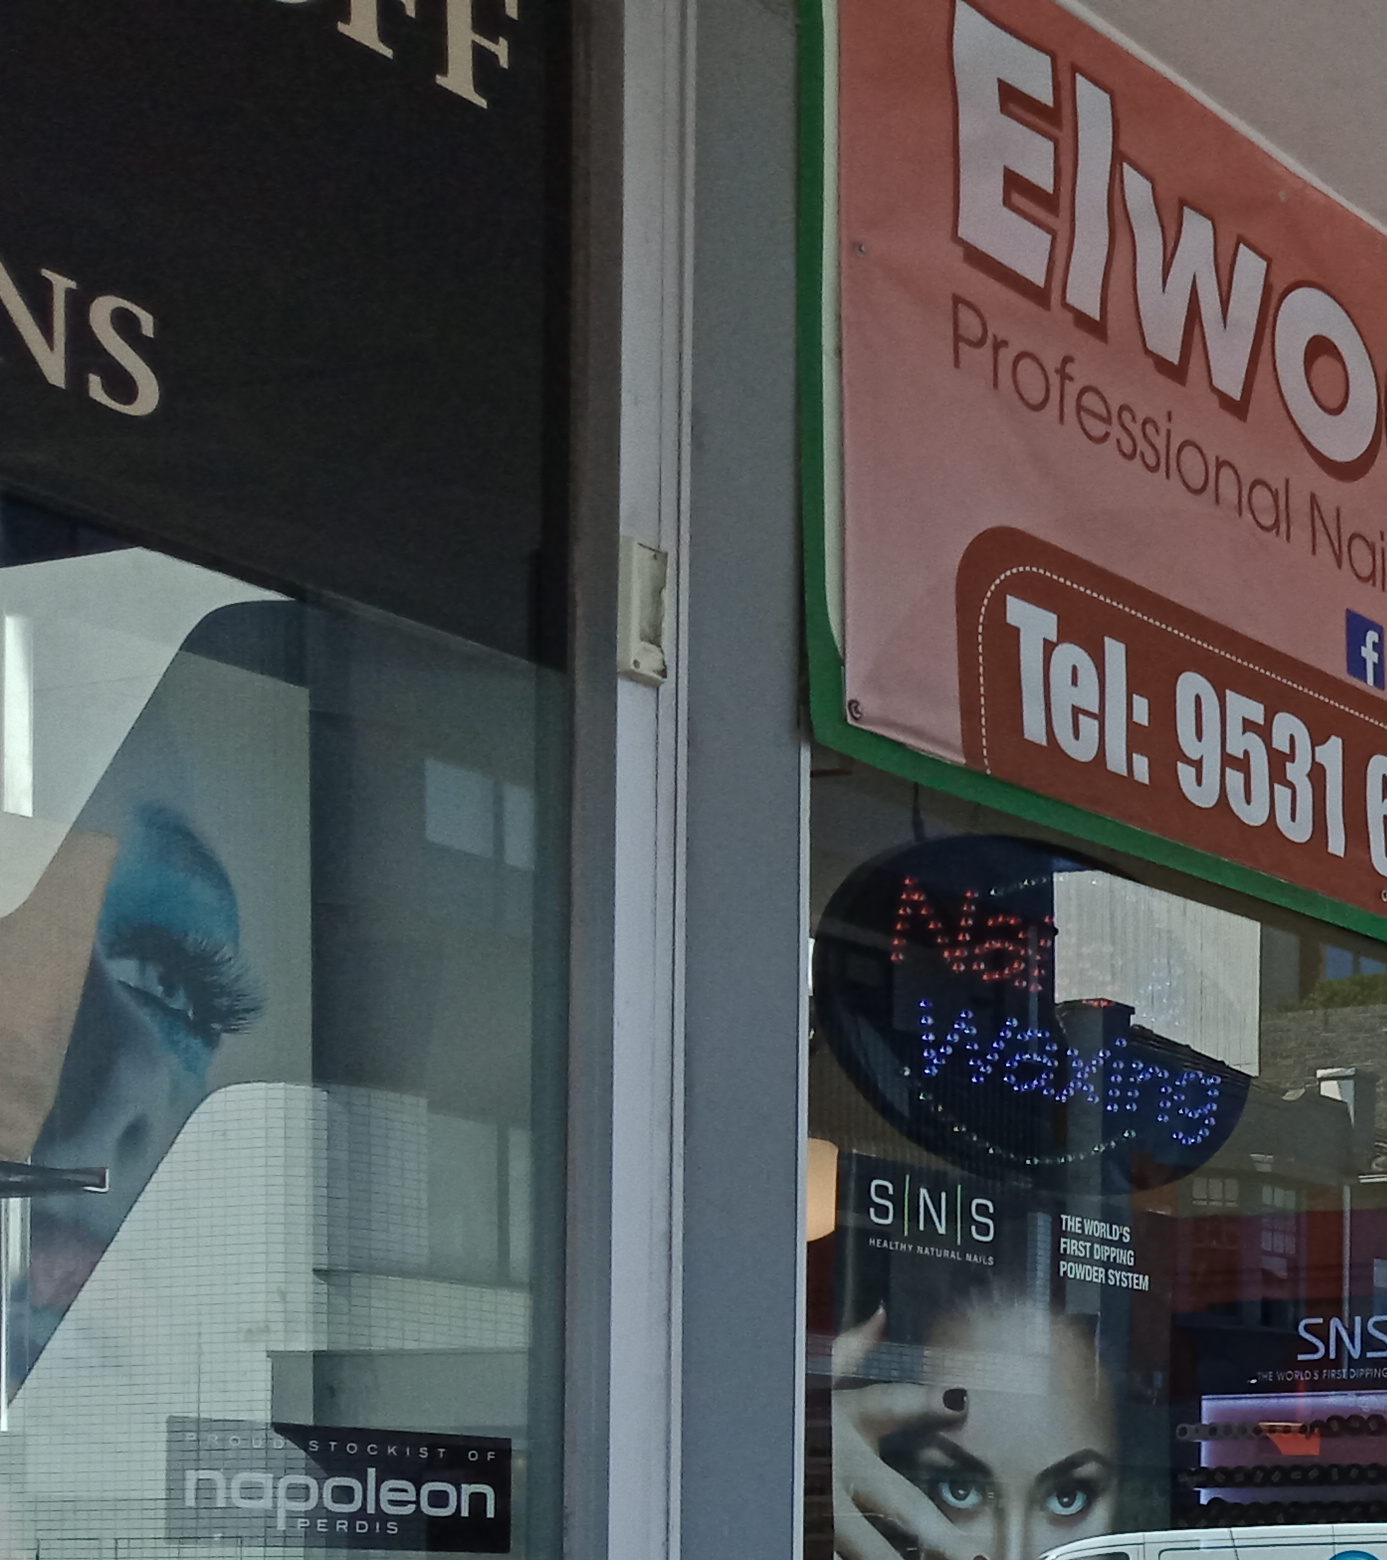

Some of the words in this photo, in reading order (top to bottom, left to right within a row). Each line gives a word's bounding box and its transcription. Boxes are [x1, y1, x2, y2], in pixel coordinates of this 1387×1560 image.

[951, 294, 1292, 543] Professional
[1006, 595, 1149, 786] Tel:
[1174, 670, 1346, 858] 9531
[1060, 1214, 1082, 1233] THE
[1083, 1219, 1131, 1243] WORLD'S
[869, 1237, 913, 1252] HEALTHY
[917, 1245, 962, 1261] NATURAL
[966, 1252, 995, 1266] NAILS
[1060, 1237, 1091, 1257] FIRST
[1093, 1243, 1134, 1266] DIPPING
[1059, 1261, 1106, 1284] POWDER
[1108, 1269, 1149, 1291] SYSTEM
[1257, 1371, 1273, 1382] THE
[1323, 1368, 1349, 1380] FIRST
[185, 1433, 285, 1450] PROUD
[309, 1440, 447, 1458] STOCKIST
[467, 1450, 497, 1461] OF
[184, 1467, 496, 1531] napoleon
[297, 1518, 400, 1535] PERDIS
